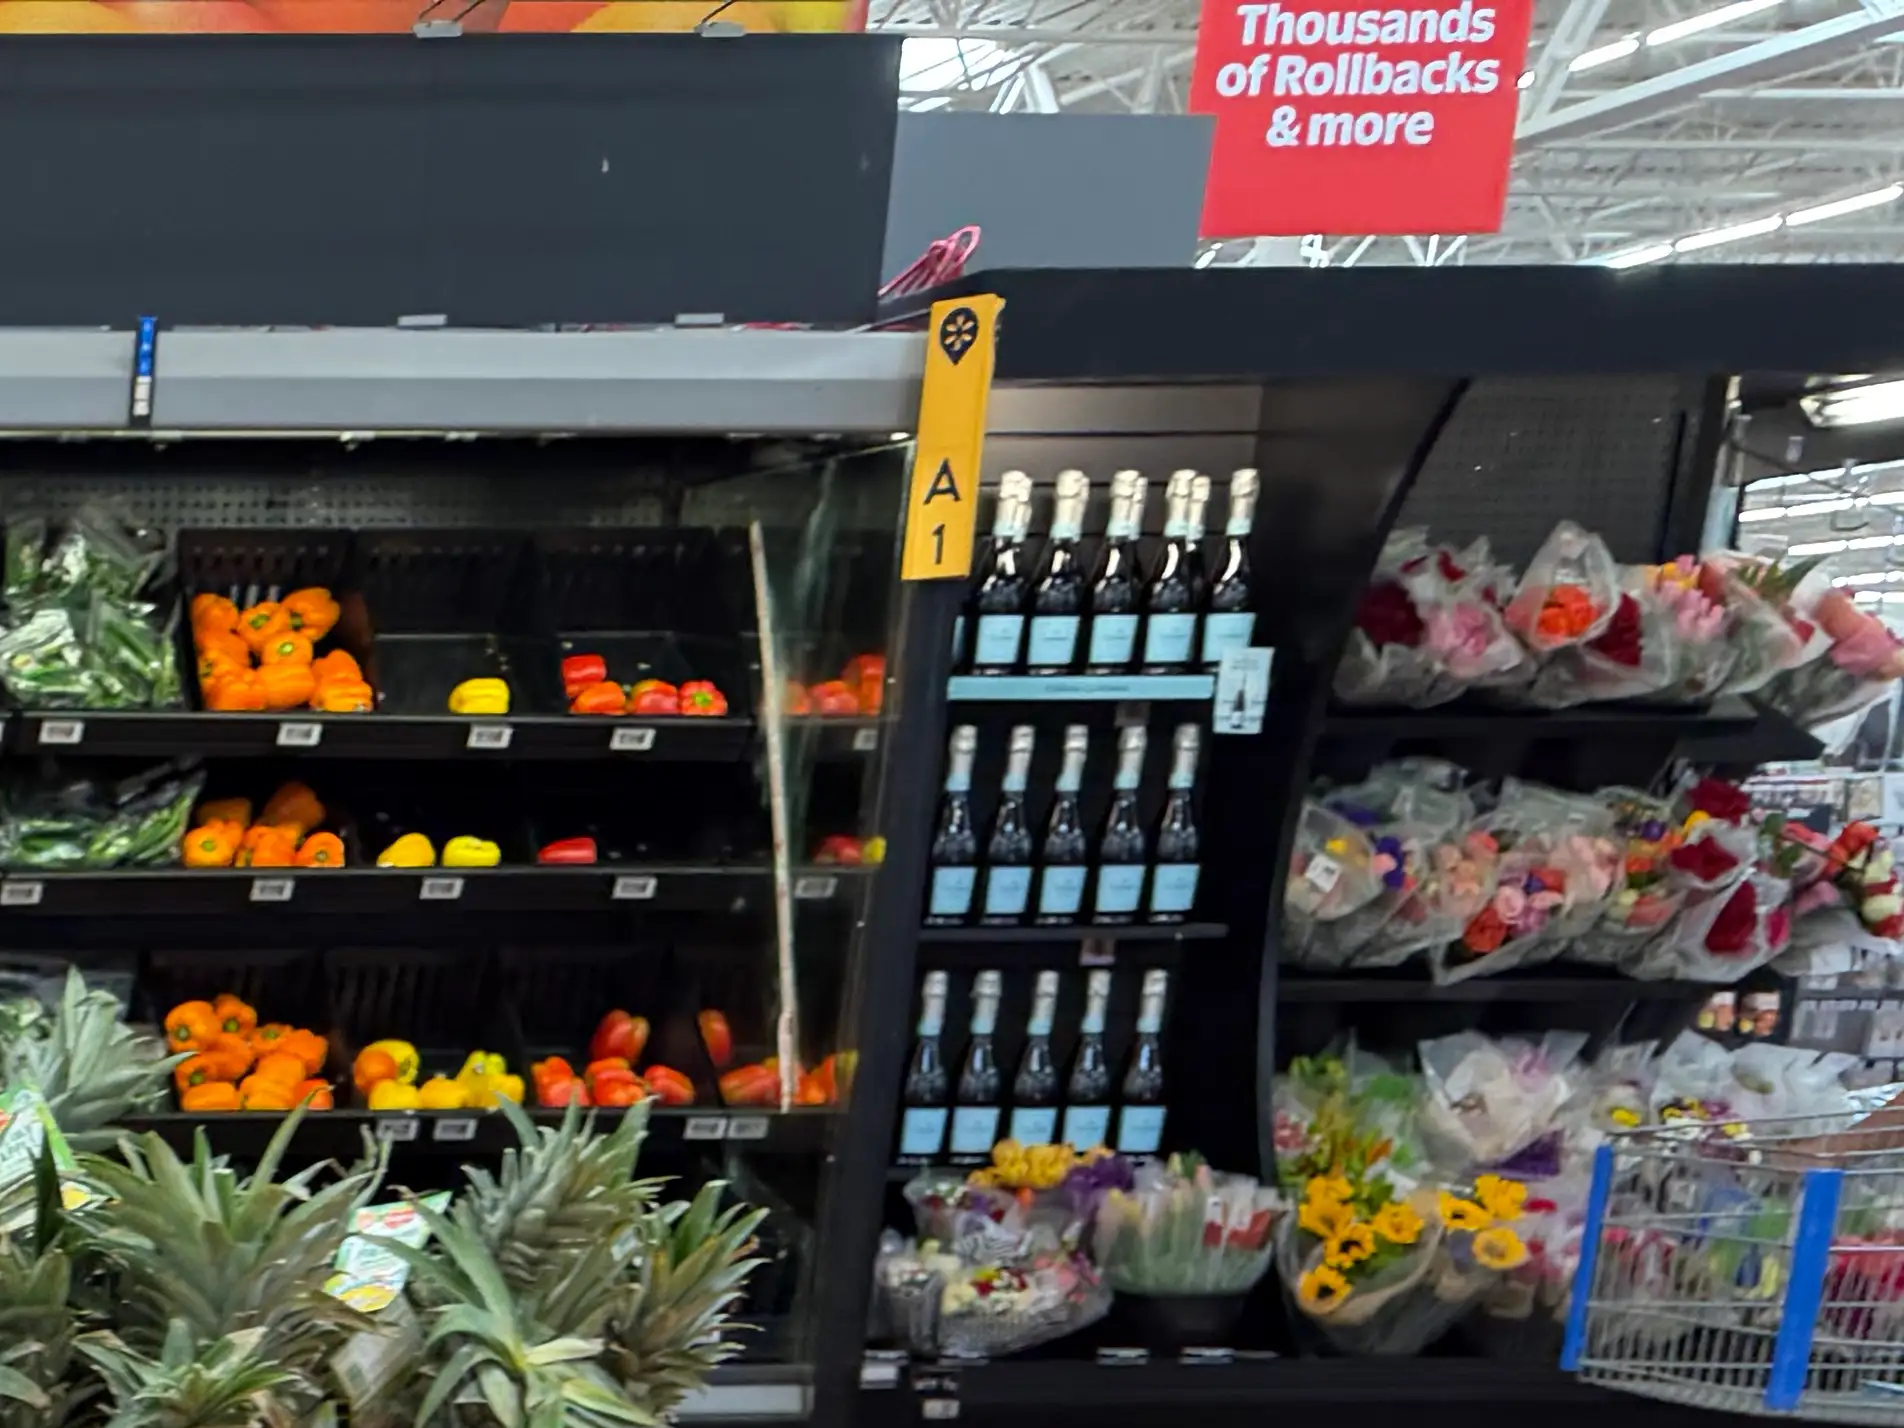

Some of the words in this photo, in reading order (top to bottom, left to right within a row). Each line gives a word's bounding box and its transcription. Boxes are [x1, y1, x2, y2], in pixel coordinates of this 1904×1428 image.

[1237, 0, 1496, 46] Thousands
[1215, 53, 1272, 97] of
[1273, 51, 1500, 97] Rollbacks
[1265, 104, 1301, 147] &
[1306, 110, 1435, 147] more
[923, 456, 962, 506] A
[931, 523, 946, 566] 1
